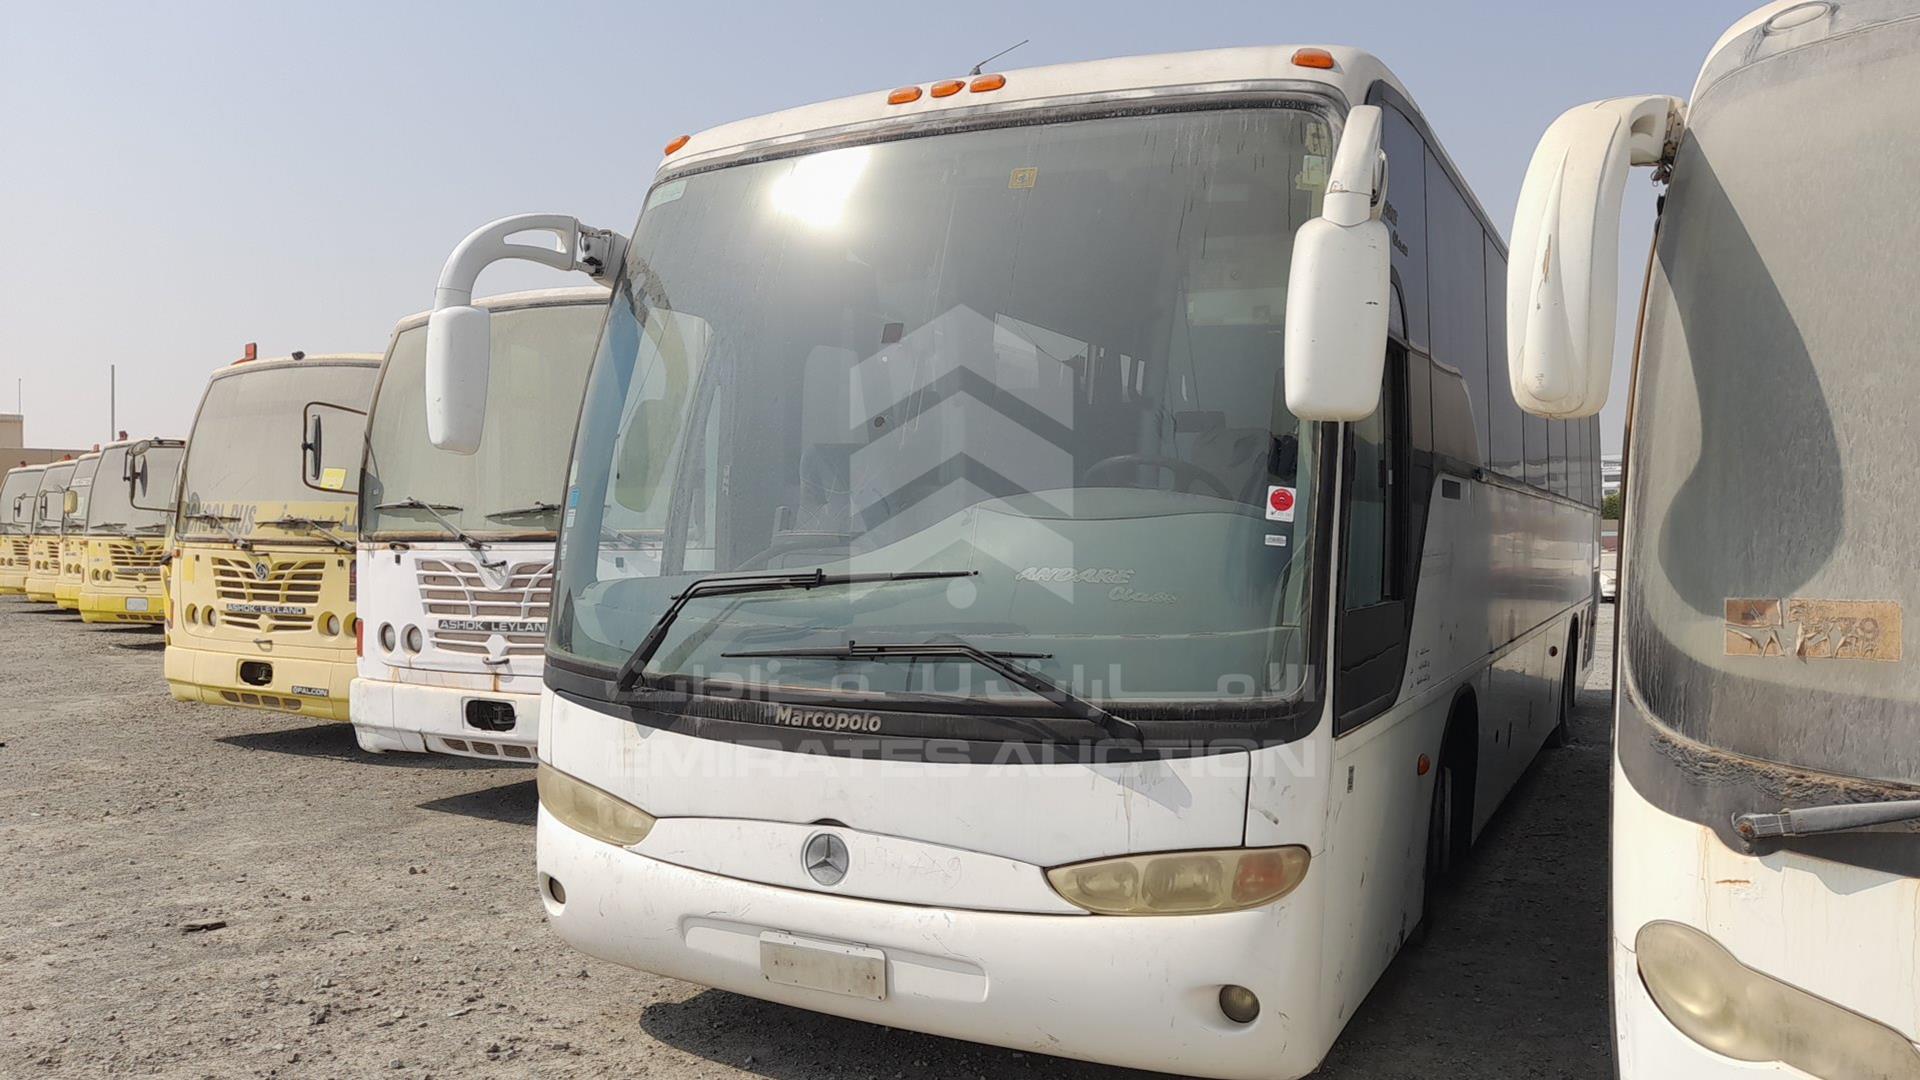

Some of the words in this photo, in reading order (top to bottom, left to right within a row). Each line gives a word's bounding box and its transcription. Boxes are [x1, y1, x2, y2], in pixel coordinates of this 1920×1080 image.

[227, 603, 258, 613] ASHOK
[260, 605, 305, 615] LEYLAND
[439, 620, 484, 631] ASHOK
[491, 621, 547, 633] LEYLAN
[296, 687, 328, 697] FALCON
[774, 704, 883, 733] Marcopolo
